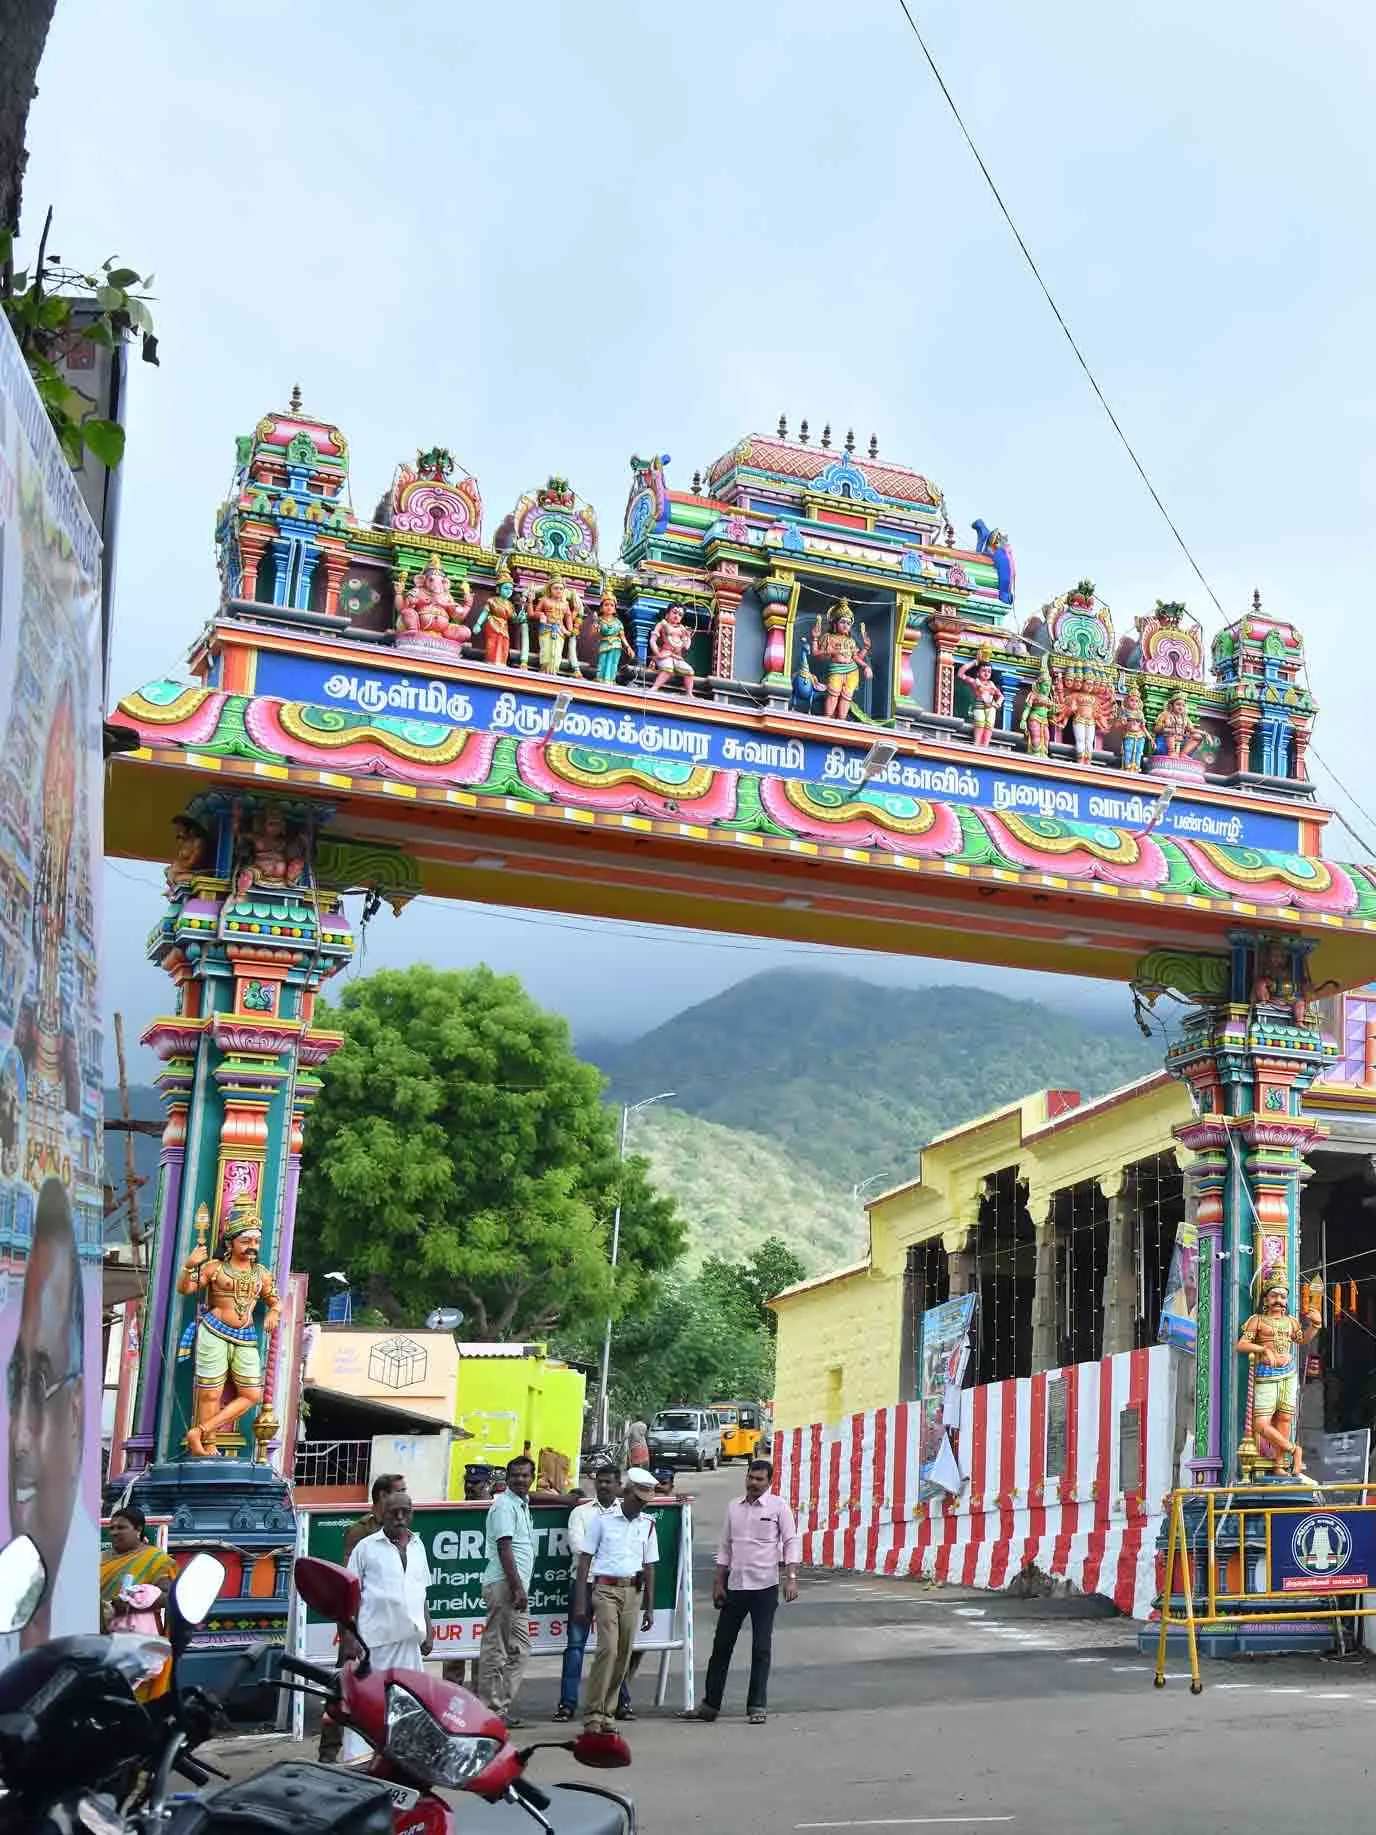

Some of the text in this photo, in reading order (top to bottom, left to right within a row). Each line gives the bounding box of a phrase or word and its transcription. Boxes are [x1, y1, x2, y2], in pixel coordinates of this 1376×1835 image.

[323, 674, 473, 722] அருள்மிகு
[722, 738, 805, 770] சுவாமி
[993, 781, 1079, 818] நுழைவு
